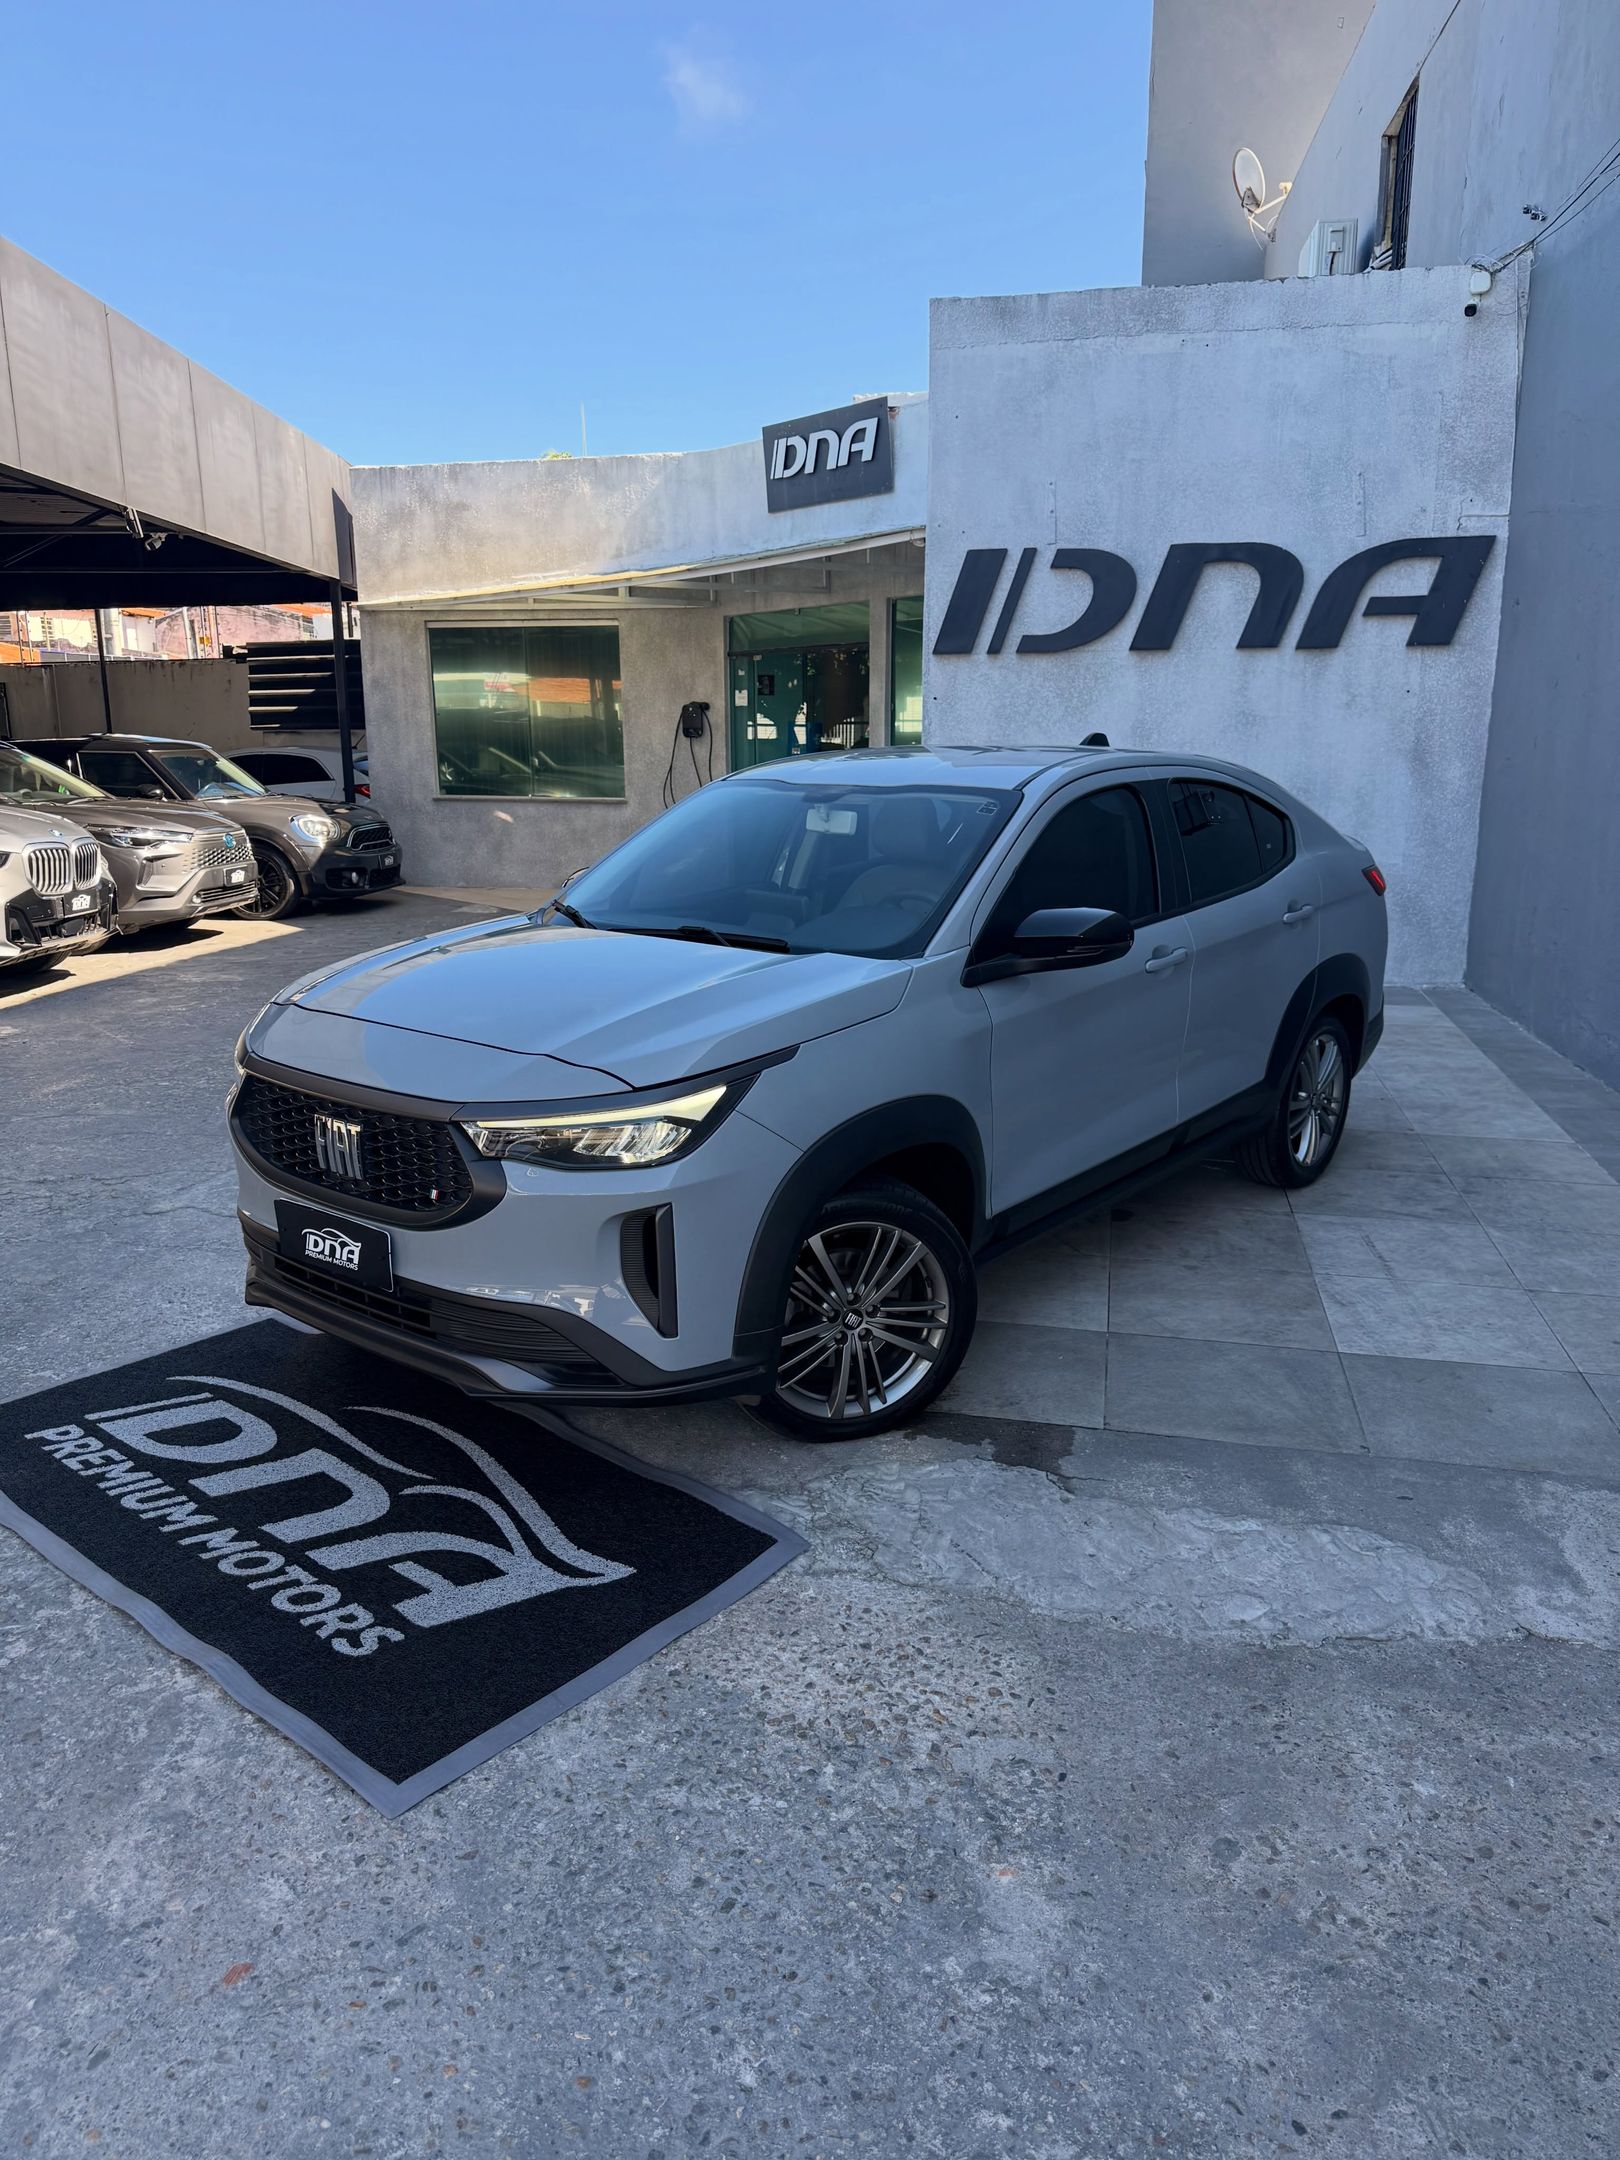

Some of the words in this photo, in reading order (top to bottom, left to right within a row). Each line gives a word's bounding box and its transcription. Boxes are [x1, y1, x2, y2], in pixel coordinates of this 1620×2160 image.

[314, 1113, 363, 1180] FIAT
[304, 1249, 332, 1263] PREMIUM
[333, 1258, 358, 1271] MOTORS
[844, 1312, 862, 1328] FIAT
[25, 1424, 218, 1533] PREMIUM
[178, 1526, 405, 1657] MOTORS
